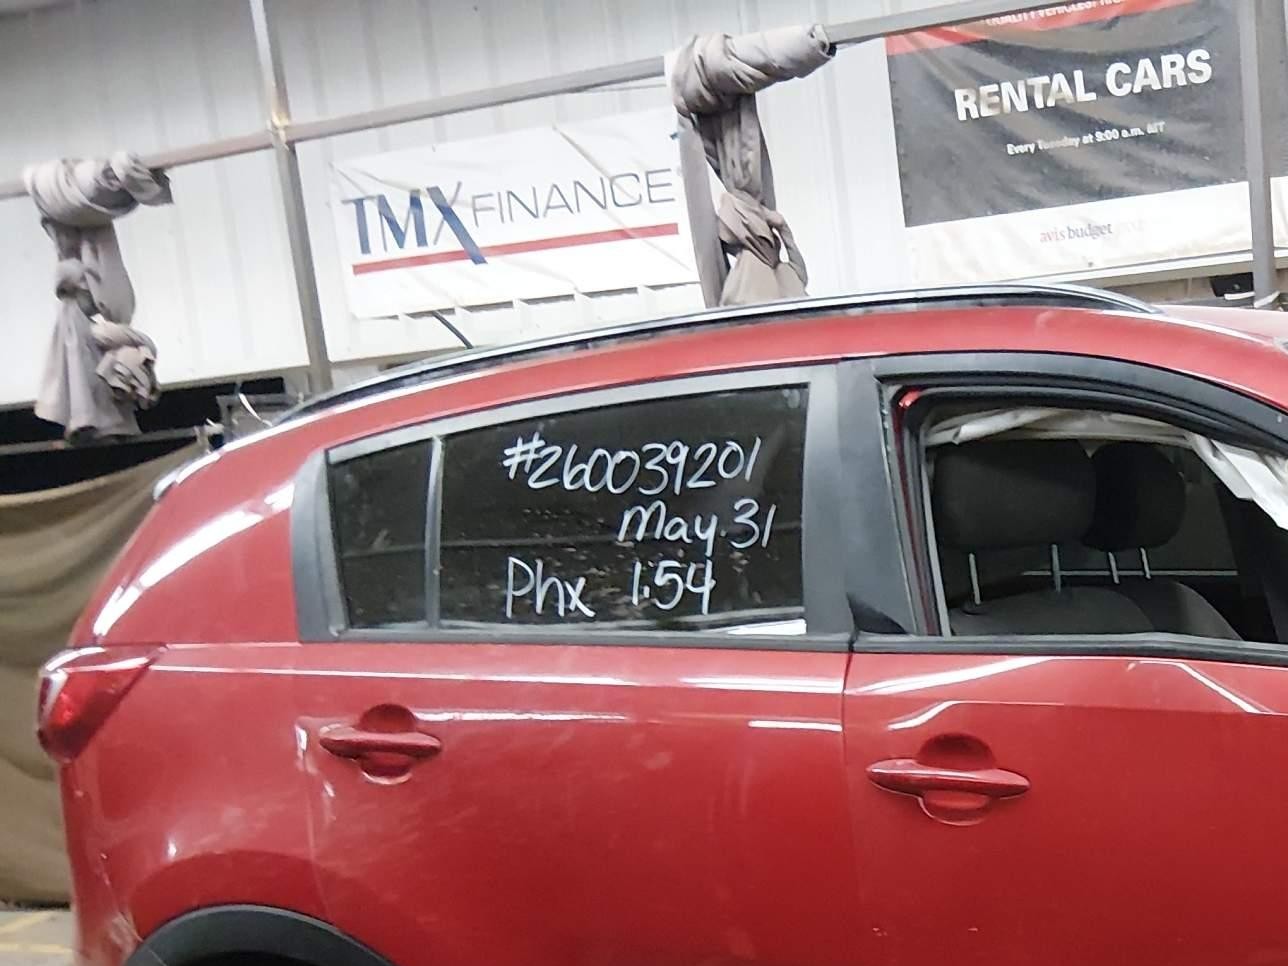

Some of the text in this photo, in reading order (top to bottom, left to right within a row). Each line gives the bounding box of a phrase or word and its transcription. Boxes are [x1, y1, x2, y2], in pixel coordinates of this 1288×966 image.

[954, 48, 1213, 121] RENTAL CARS
[1007, 141, 1036, 156] Every
[1082, 132, 1094, 144] at
[341, 168, 675, 264] TMX FINANCE
[1066, 223, 1113, 240] budget
[503, 432, 762, 496] #260039201
